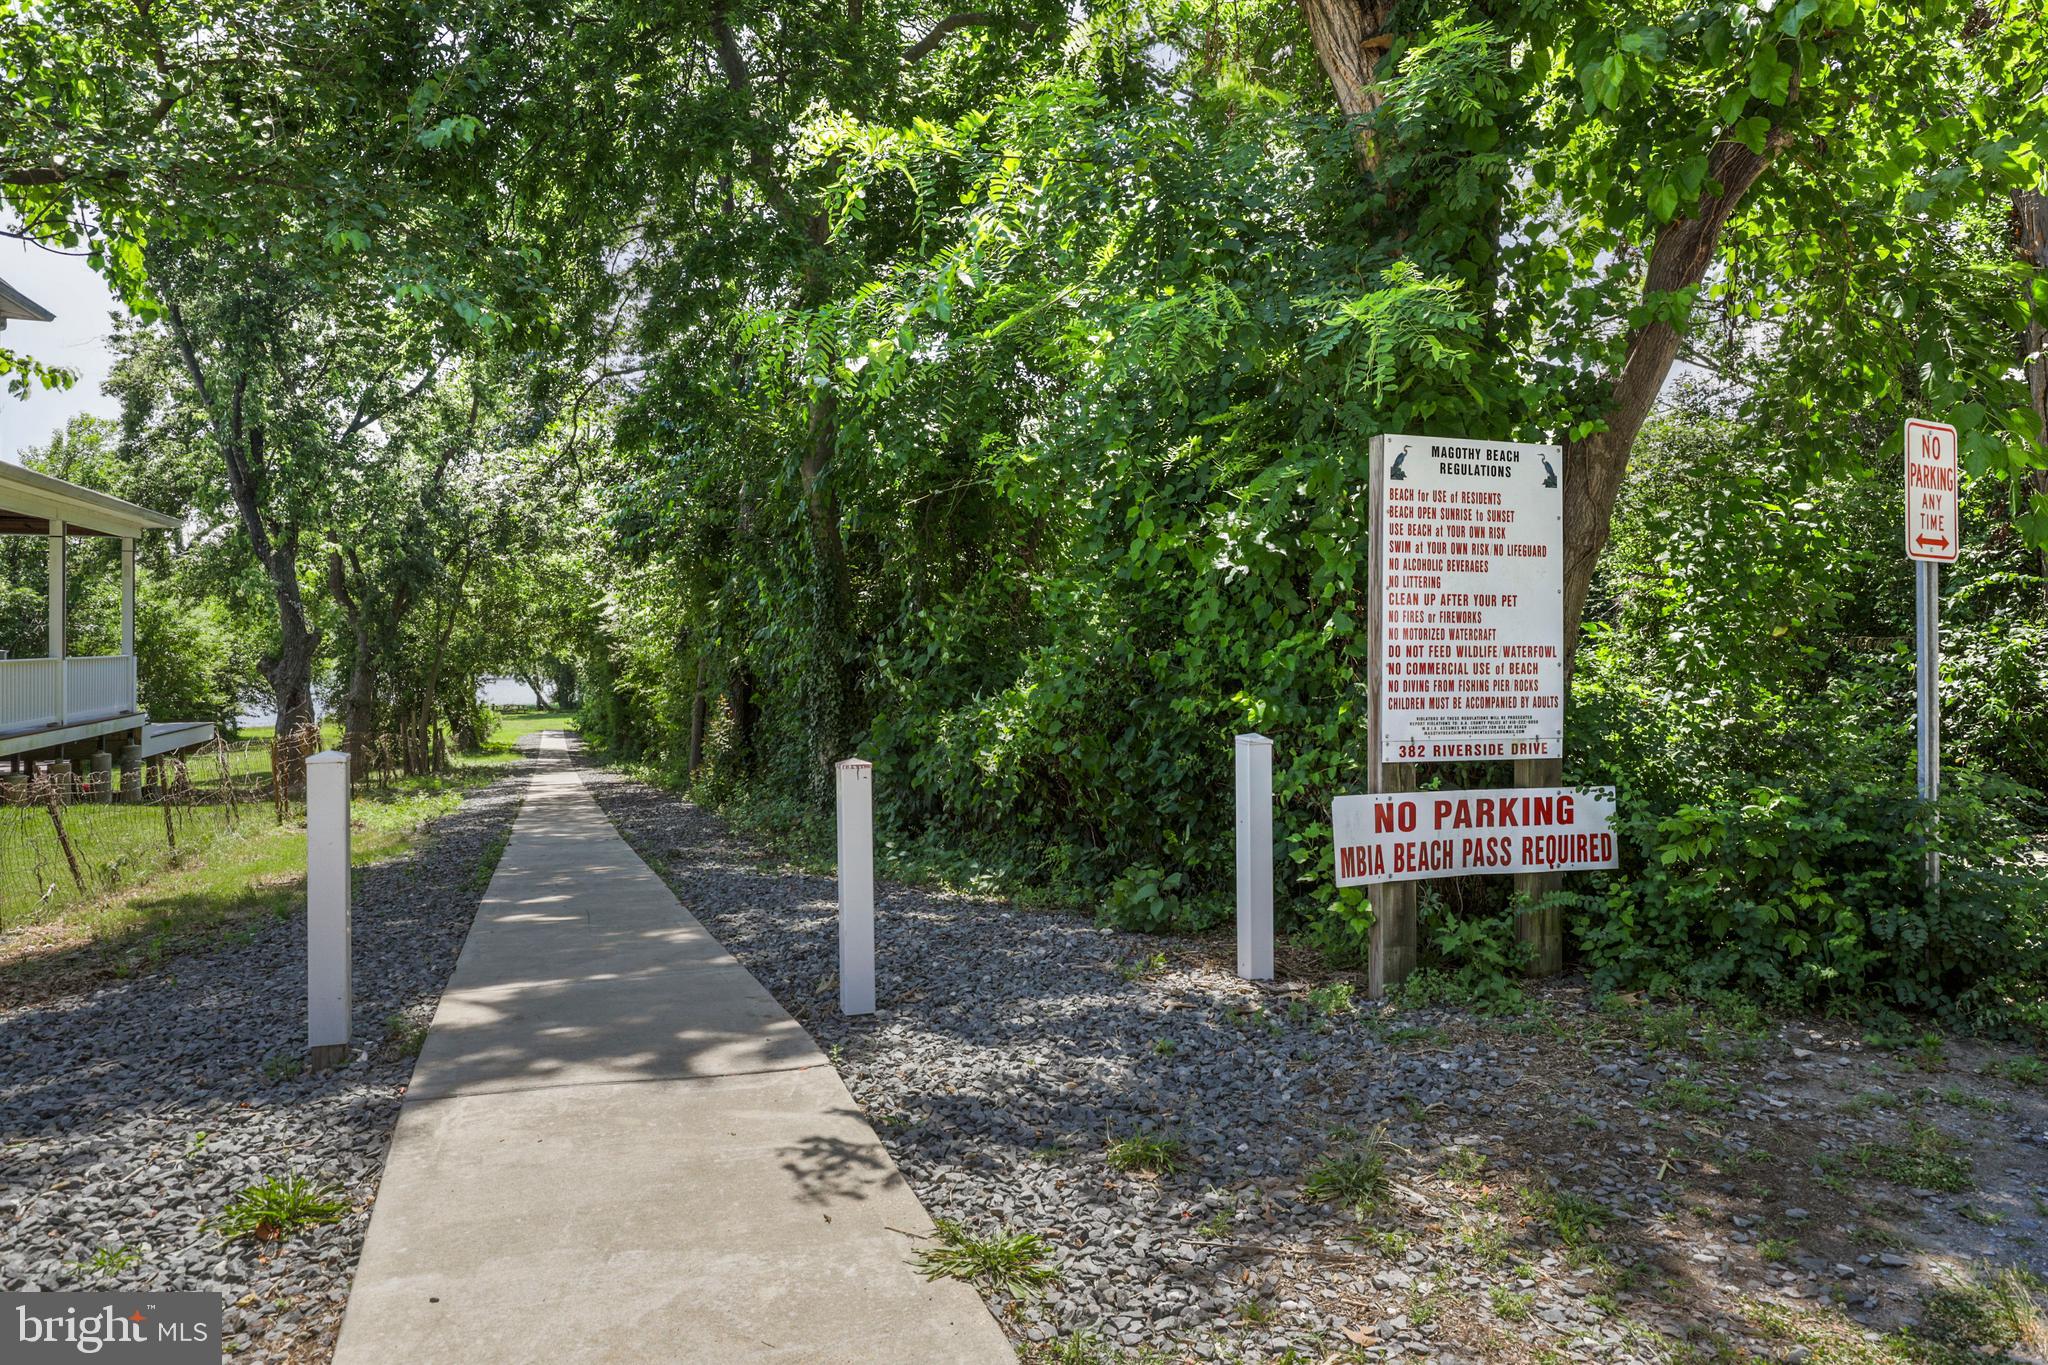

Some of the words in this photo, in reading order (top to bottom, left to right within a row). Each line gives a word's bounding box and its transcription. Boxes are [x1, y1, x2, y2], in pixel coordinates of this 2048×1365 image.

[1432, 446, 1481, 460] MAGOTHY
[1487, 450, 1520, 462] BEACH
[1922, 435, 1940, 460] NO
[1440, 462, 1512, 478] REGULATIONS
[1910, 463, 1953, 492] PARKING
[1389, 488, 1414, 501] BEACH
[1418, 489, 1429, 501] for
[1432, 490, 1447, 502] USE
[1450, 491, 1458, 503] of
[1462, 492, 1501, 505] RESIDENTS
[1922, 493, 1942, 510] ANY
[1389, 506, 1414, 518] BEACH
[1418, 507, 1437, 519] OPEN
[1441, 508, 1472, 521] SUNRISE
[1476, 510, 1483, 521] to
[1487, 510, 1515, 522] SUNSET
[1920, 513, 1944, 531] TIME
[1389, 523, 1403, 536] USE
[1408, 524, 1432, 537] BEACH
[1436, 525, 1443, 537] at
[1447, 526, 1465, 538] YOUR
[1469, 526, 1485, 538] OWN
[1489, 527, 1506, 539] RISK
[1389, 541, 1411, 553] SWIM
[1415, 542, 1423, 553] at
[1428, 542, 1447, 554] YOUR
[1451, 543, 1468, 555] OWN
[1507, 545, 1547, 557] LIFEGUARD
[1389, 558, 1399, 570] NO
[1403, 559, 1443, 571] ALCOHOLIC
[1447, 560, 1488, 572] BEVERAGES
[1389, 576, 1399, 588] NO
[1402, 576, 1441, 589] LITTERING
[1388, 593, 1419, 606] CLEAN
[1424, 594, 1436, 606] UP
[1440, 594, 1468, 606] AFTER
[1473, 595, 1497, 607] YOUR
[1502, 595, 1517, 607] PET
[1388, 611, 1398, 623] NO
[1402, 611, 1424, 623] FIRES
[1428, 613, 1435, 623] or
[1439, 612, 1482, 624] FIREWORKS
[1388, 628, 1399, 640] NO
[1402, 628, 1445, 640] MOTORIZED
[1449, 629, 1496, 641] WATERCRAFT
[1388, 645, 1400, 658] DO
[1406, 646, 1424, 658] NOT
[1429, 646, 1451, 658] FEED
[1388, 663, 1401, 675] NO
[1406, 662, 1468, 675] COMMERCIAL
[1473, 662, 1490, 675] USE
[1495, 663, 1504, 675] of
[1509, 662, 1538, 675] BEACH
[1388, 680, 1399, 692] NO
[1403, 680, 1429, 692] DIVING
[1433, 680, 1454, 692] FROM
[1458, 680, 1489, 692] FISHING
[1388, 697, 1425, 710] CHILDREN
[1429, 697, 1449, 709] MUST
[1453, 697, 1462, 709] BE
[1465, 696, 1517, 708] ACCOMPANIED
[1521, 696, 1529, 708] BY
[1532, 696, 1558, 708] ADULTS
[1399, 745, 1425, 757] 382
[1433, 744, 1504, 757] RIVERSIDE
[1512, 742, 1548, 754] DRIVE
[1374, 801, 1416, 834] NO
[1434, 795, 1574, 830] PARKING
[1340, 844, 1385, 878] MBIA
[1394, 839, 1454, 873] BEACH
[1462, 836, 1512, 868] PASS
[1522, 832, 1612, 869] REQUIRED
